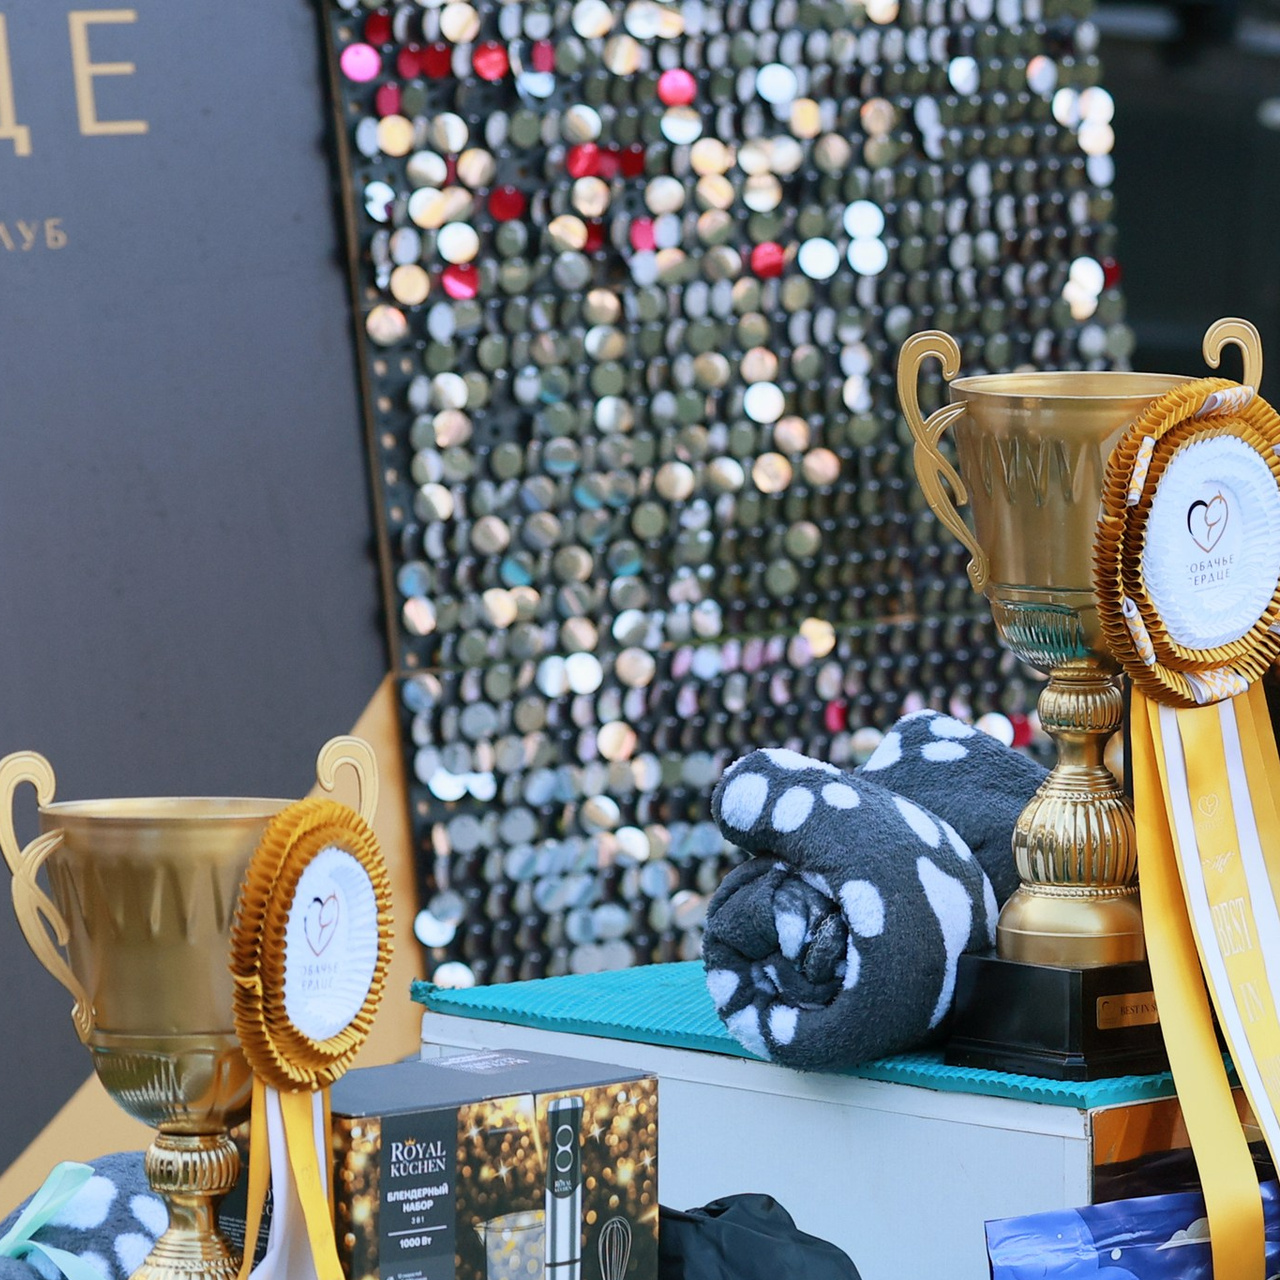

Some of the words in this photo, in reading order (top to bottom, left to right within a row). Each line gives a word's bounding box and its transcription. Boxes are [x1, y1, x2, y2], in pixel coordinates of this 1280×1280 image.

[1186, 554, 1235, 574] ОБАЧЬЕ
[1189, 567, 1231, 586] ЕРДЦЕ
[1211, 896, 1254, 958] BEST
[390, 1140, 447, 1162] ROYAL
[390, 1158, 446, 1178] KÜCHEN
[386, 1182, 449, 1203] БЛЕНДЕРНЫЙ
[402, 1199, 434, 1213] НАБОР
[400, 1237, 420, 1249] 1000
[421, 1235, 432, 1247] Вт
